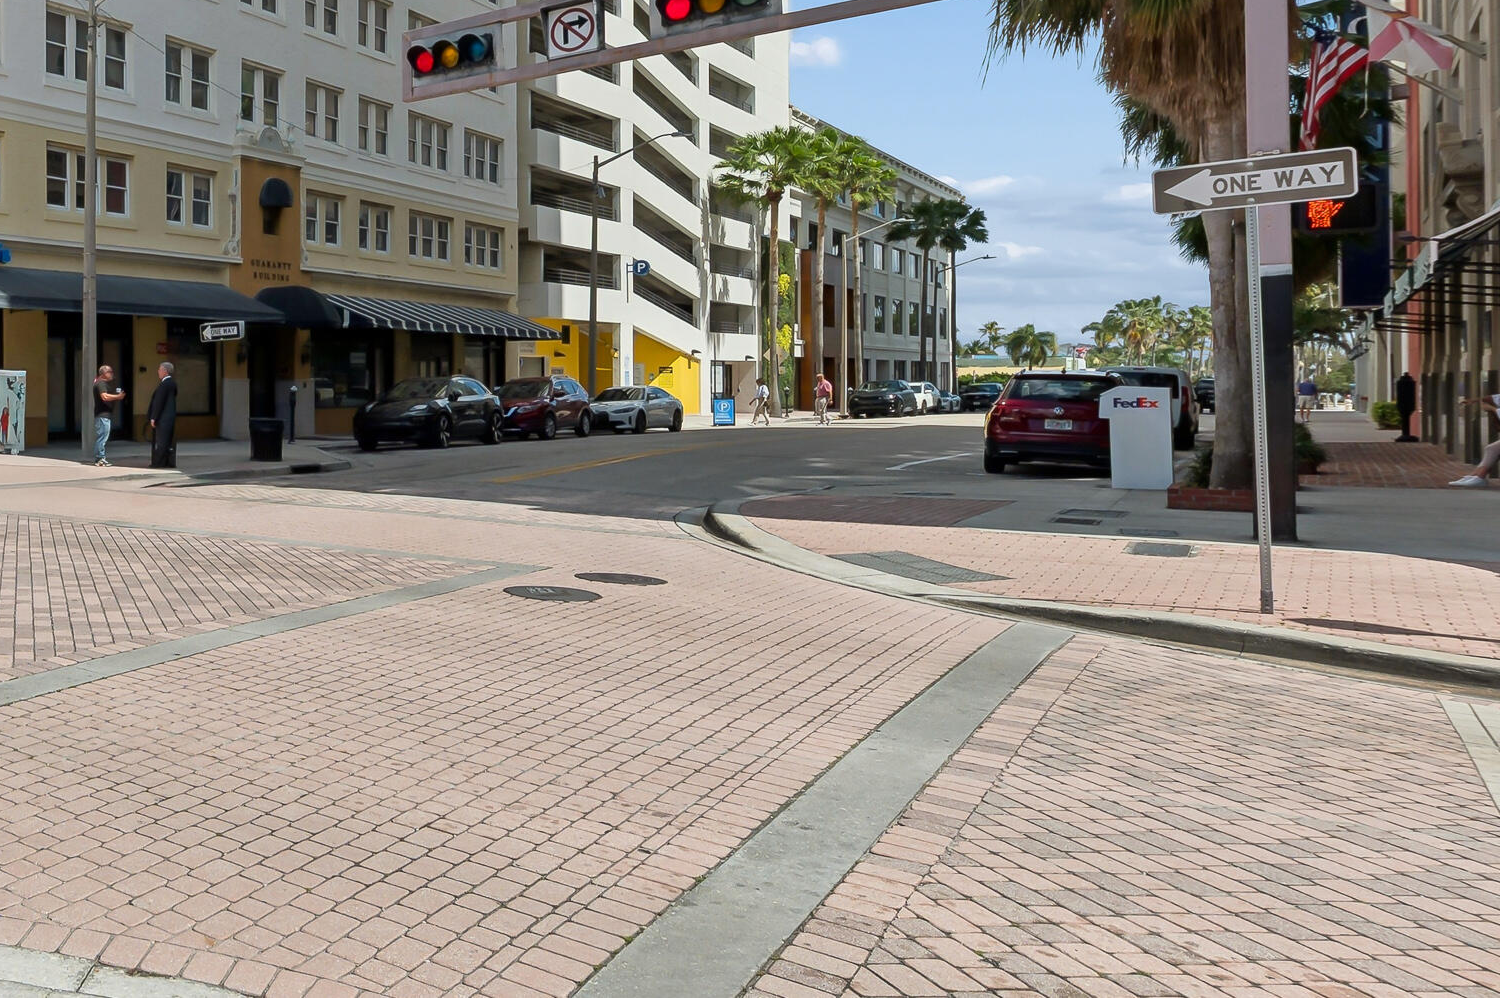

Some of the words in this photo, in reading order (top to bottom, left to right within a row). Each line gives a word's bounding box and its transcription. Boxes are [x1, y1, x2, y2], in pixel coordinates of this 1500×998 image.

[1212, 173, 1262, 195] ONE
[1273, 164, 1339, 189] WAY
[637, 262, 646, 273] P
[210, 328, 221, 336] ONE
[720, 402, 728, 411] P
[1113, 396, 1160, 409] FedEx
